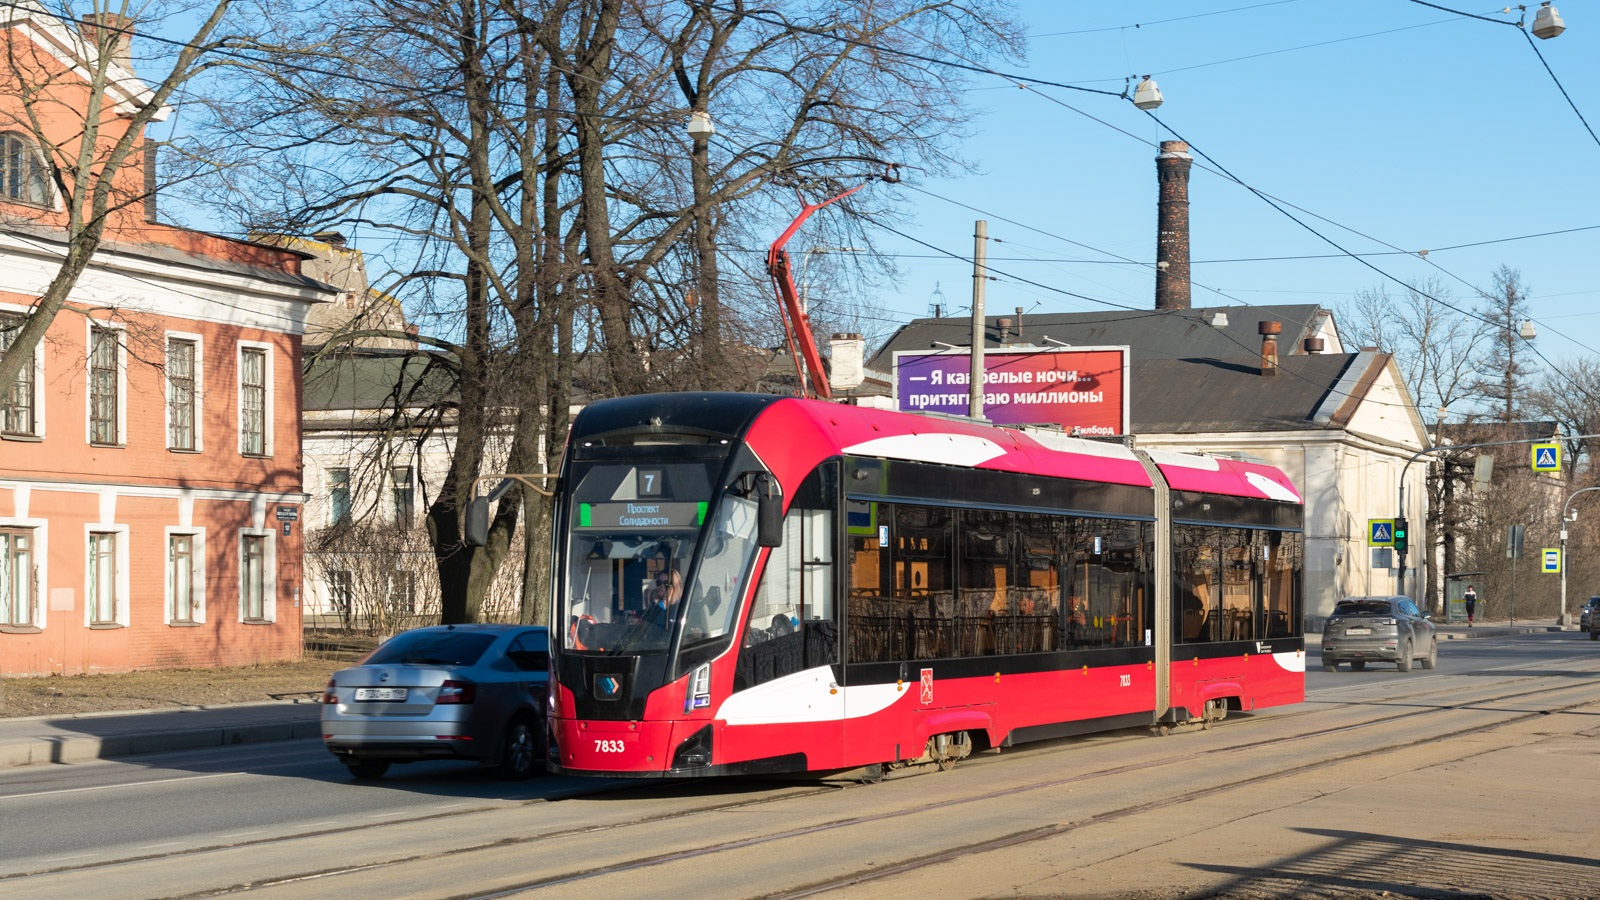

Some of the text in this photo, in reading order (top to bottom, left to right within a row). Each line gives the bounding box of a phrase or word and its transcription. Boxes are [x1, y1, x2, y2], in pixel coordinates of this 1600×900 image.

[930, 370, 943, 385] Я
[1036, 371, 1091, 383] ночи...
[909, 391, 1103, 409] притягаю миллионы
[644, 474, 655, 493] 7
[627, 503, 660, 515] Проспект
[619, 515, 669, 527] Солидарности
[1119, 674, 1131, 687] 7833
[594, 740, 625, 753] 7833
